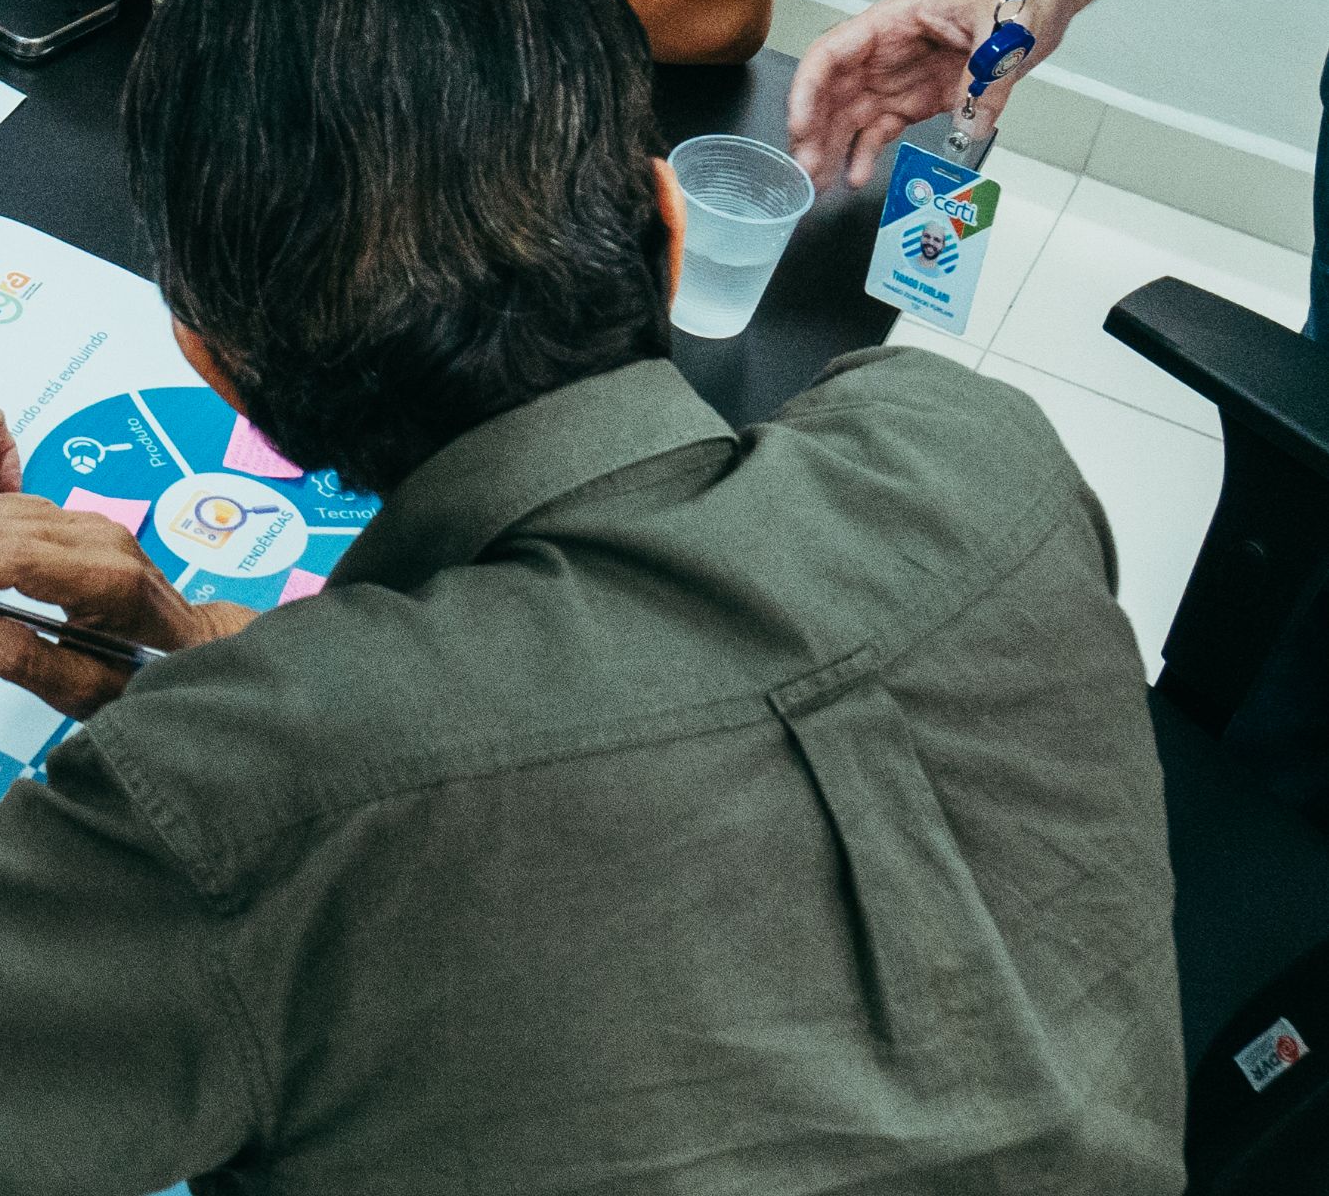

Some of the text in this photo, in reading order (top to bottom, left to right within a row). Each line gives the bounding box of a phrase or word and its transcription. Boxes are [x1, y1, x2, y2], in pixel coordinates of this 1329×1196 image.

[933, 193, 976, 225] certi
[40, 330, 109, 417] está evoluindo
[134, 417, 168, 468] Produto
[314, 507, 377, 520] Tecnol
[238, 510, 294, 572] TENDÊNCIAS
